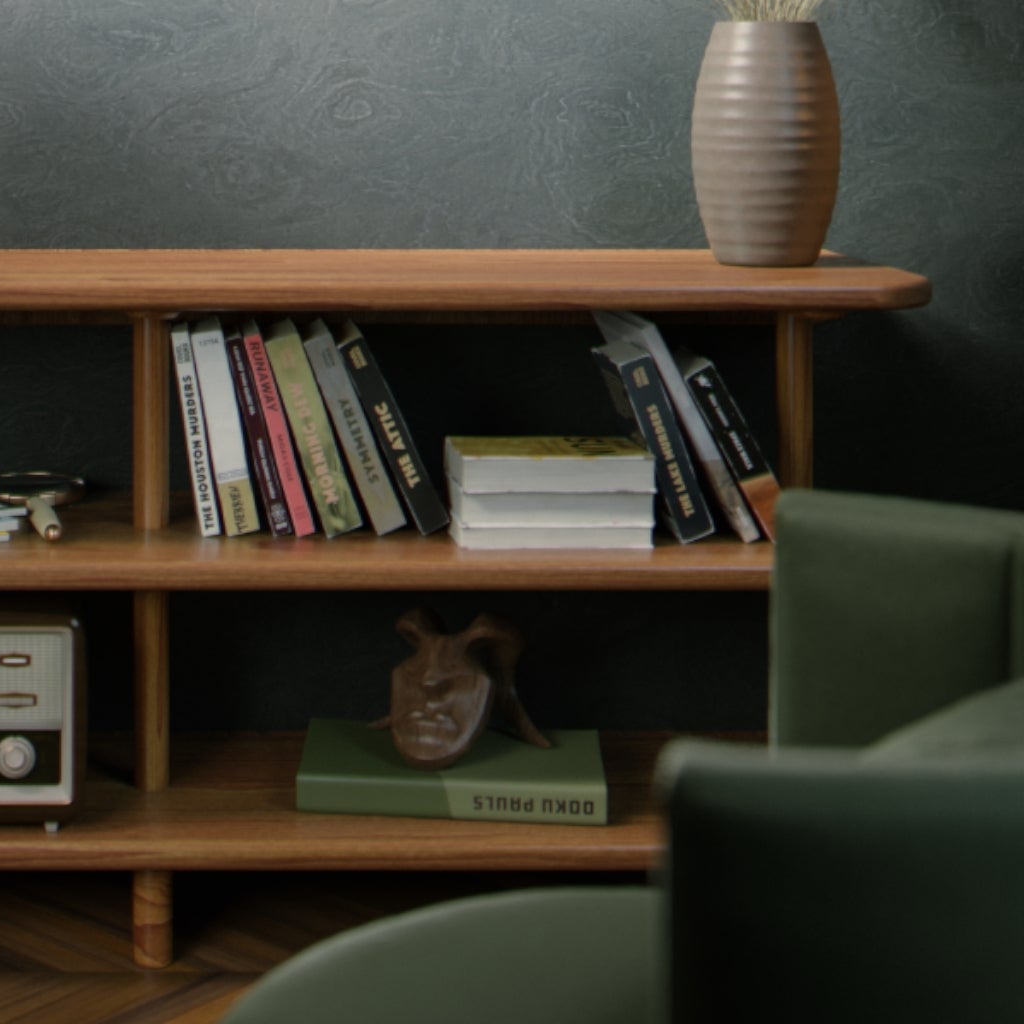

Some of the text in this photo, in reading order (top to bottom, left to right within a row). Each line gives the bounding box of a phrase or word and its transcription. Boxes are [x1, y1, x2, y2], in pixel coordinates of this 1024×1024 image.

[183, 375, 200, 436] MURDERS
[249, 342, 278, 411] RUNAWAY
[288, 382, 312, 421] DEW
[192, 440, 210, 502] HOUSTON
[303, 423, 339, 504] MORNING
[339, 398, 379, 485] SYMMETRY
[374, 401, 422, 489] THE ATTIC
[646, 404, 696, 519] THE LAKE MURDERS
[202, 505, 214, 530] THE
[472, 795, 595, 816] DOKU PAULS
